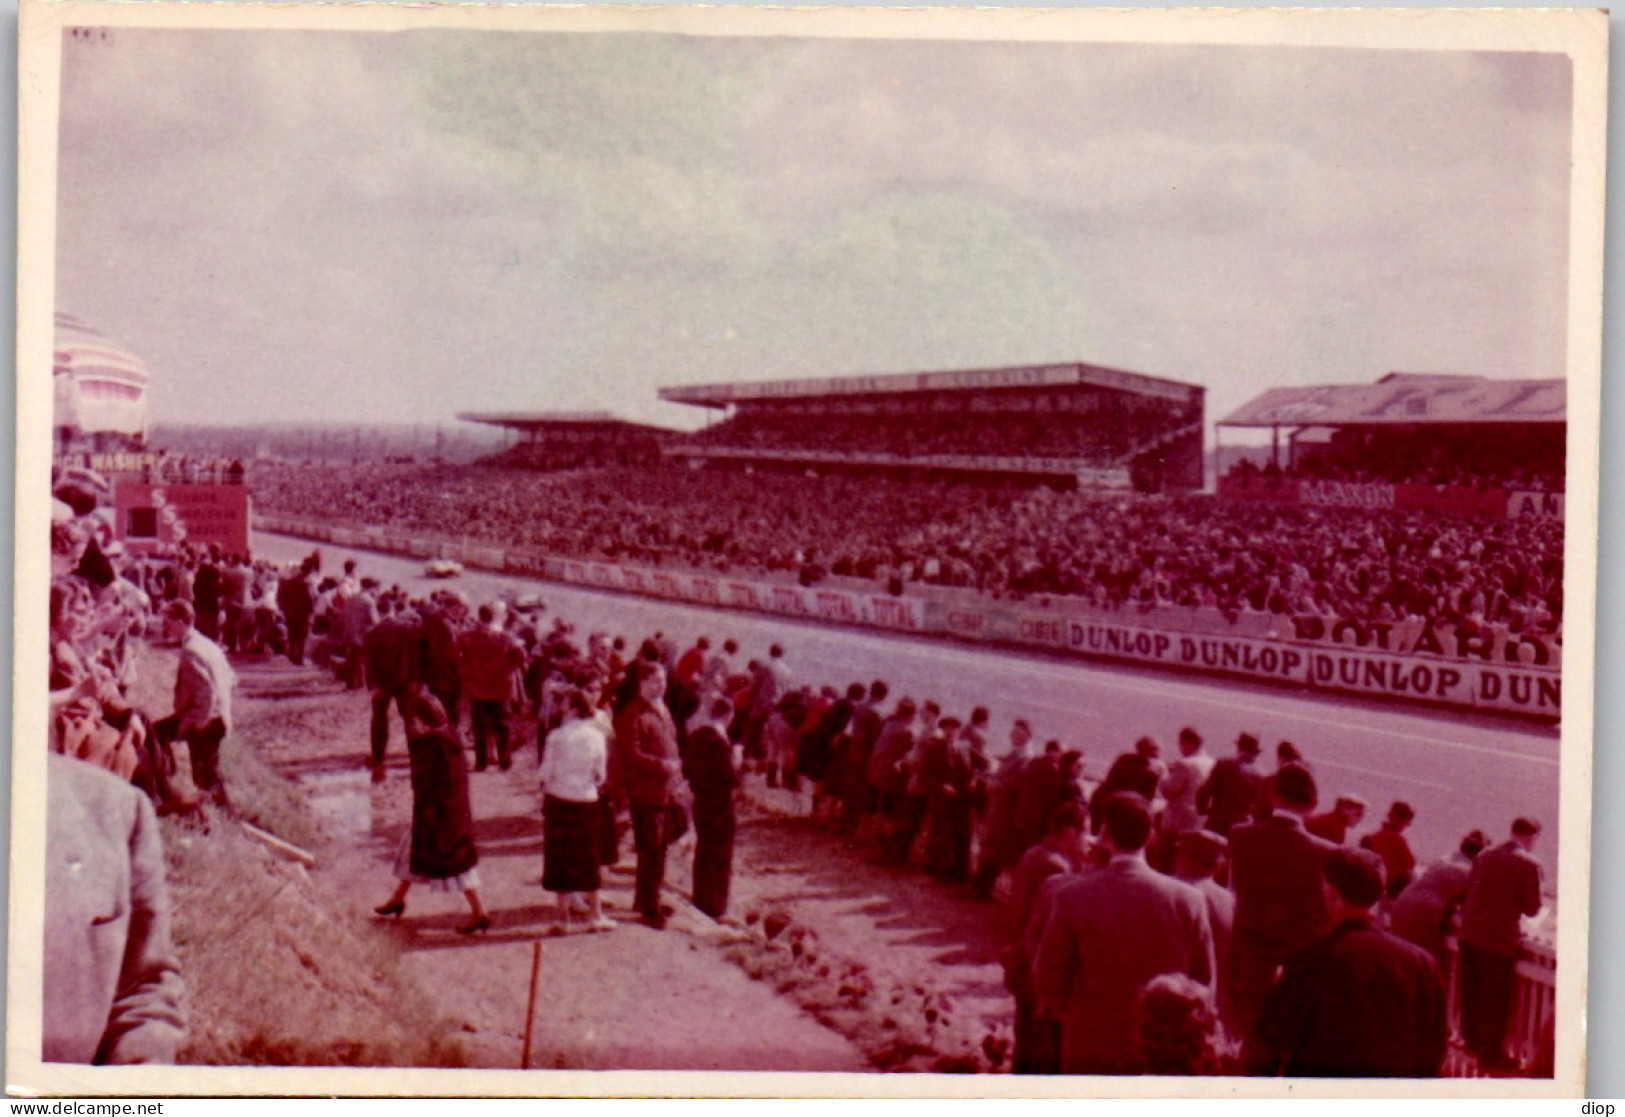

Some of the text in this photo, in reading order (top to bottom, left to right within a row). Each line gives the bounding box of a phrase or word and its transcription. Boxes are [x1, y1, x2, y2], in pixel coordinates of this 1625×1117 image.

[1519, 494, 1558, 517] AN
[1071, 623, 1170, 658] DUNLOP
[1180, 638, 1301, 676] DUNLOP
[1316, 656, 1461, 697] DUNLOP
[1479, 671, 1561, 709] DUN
